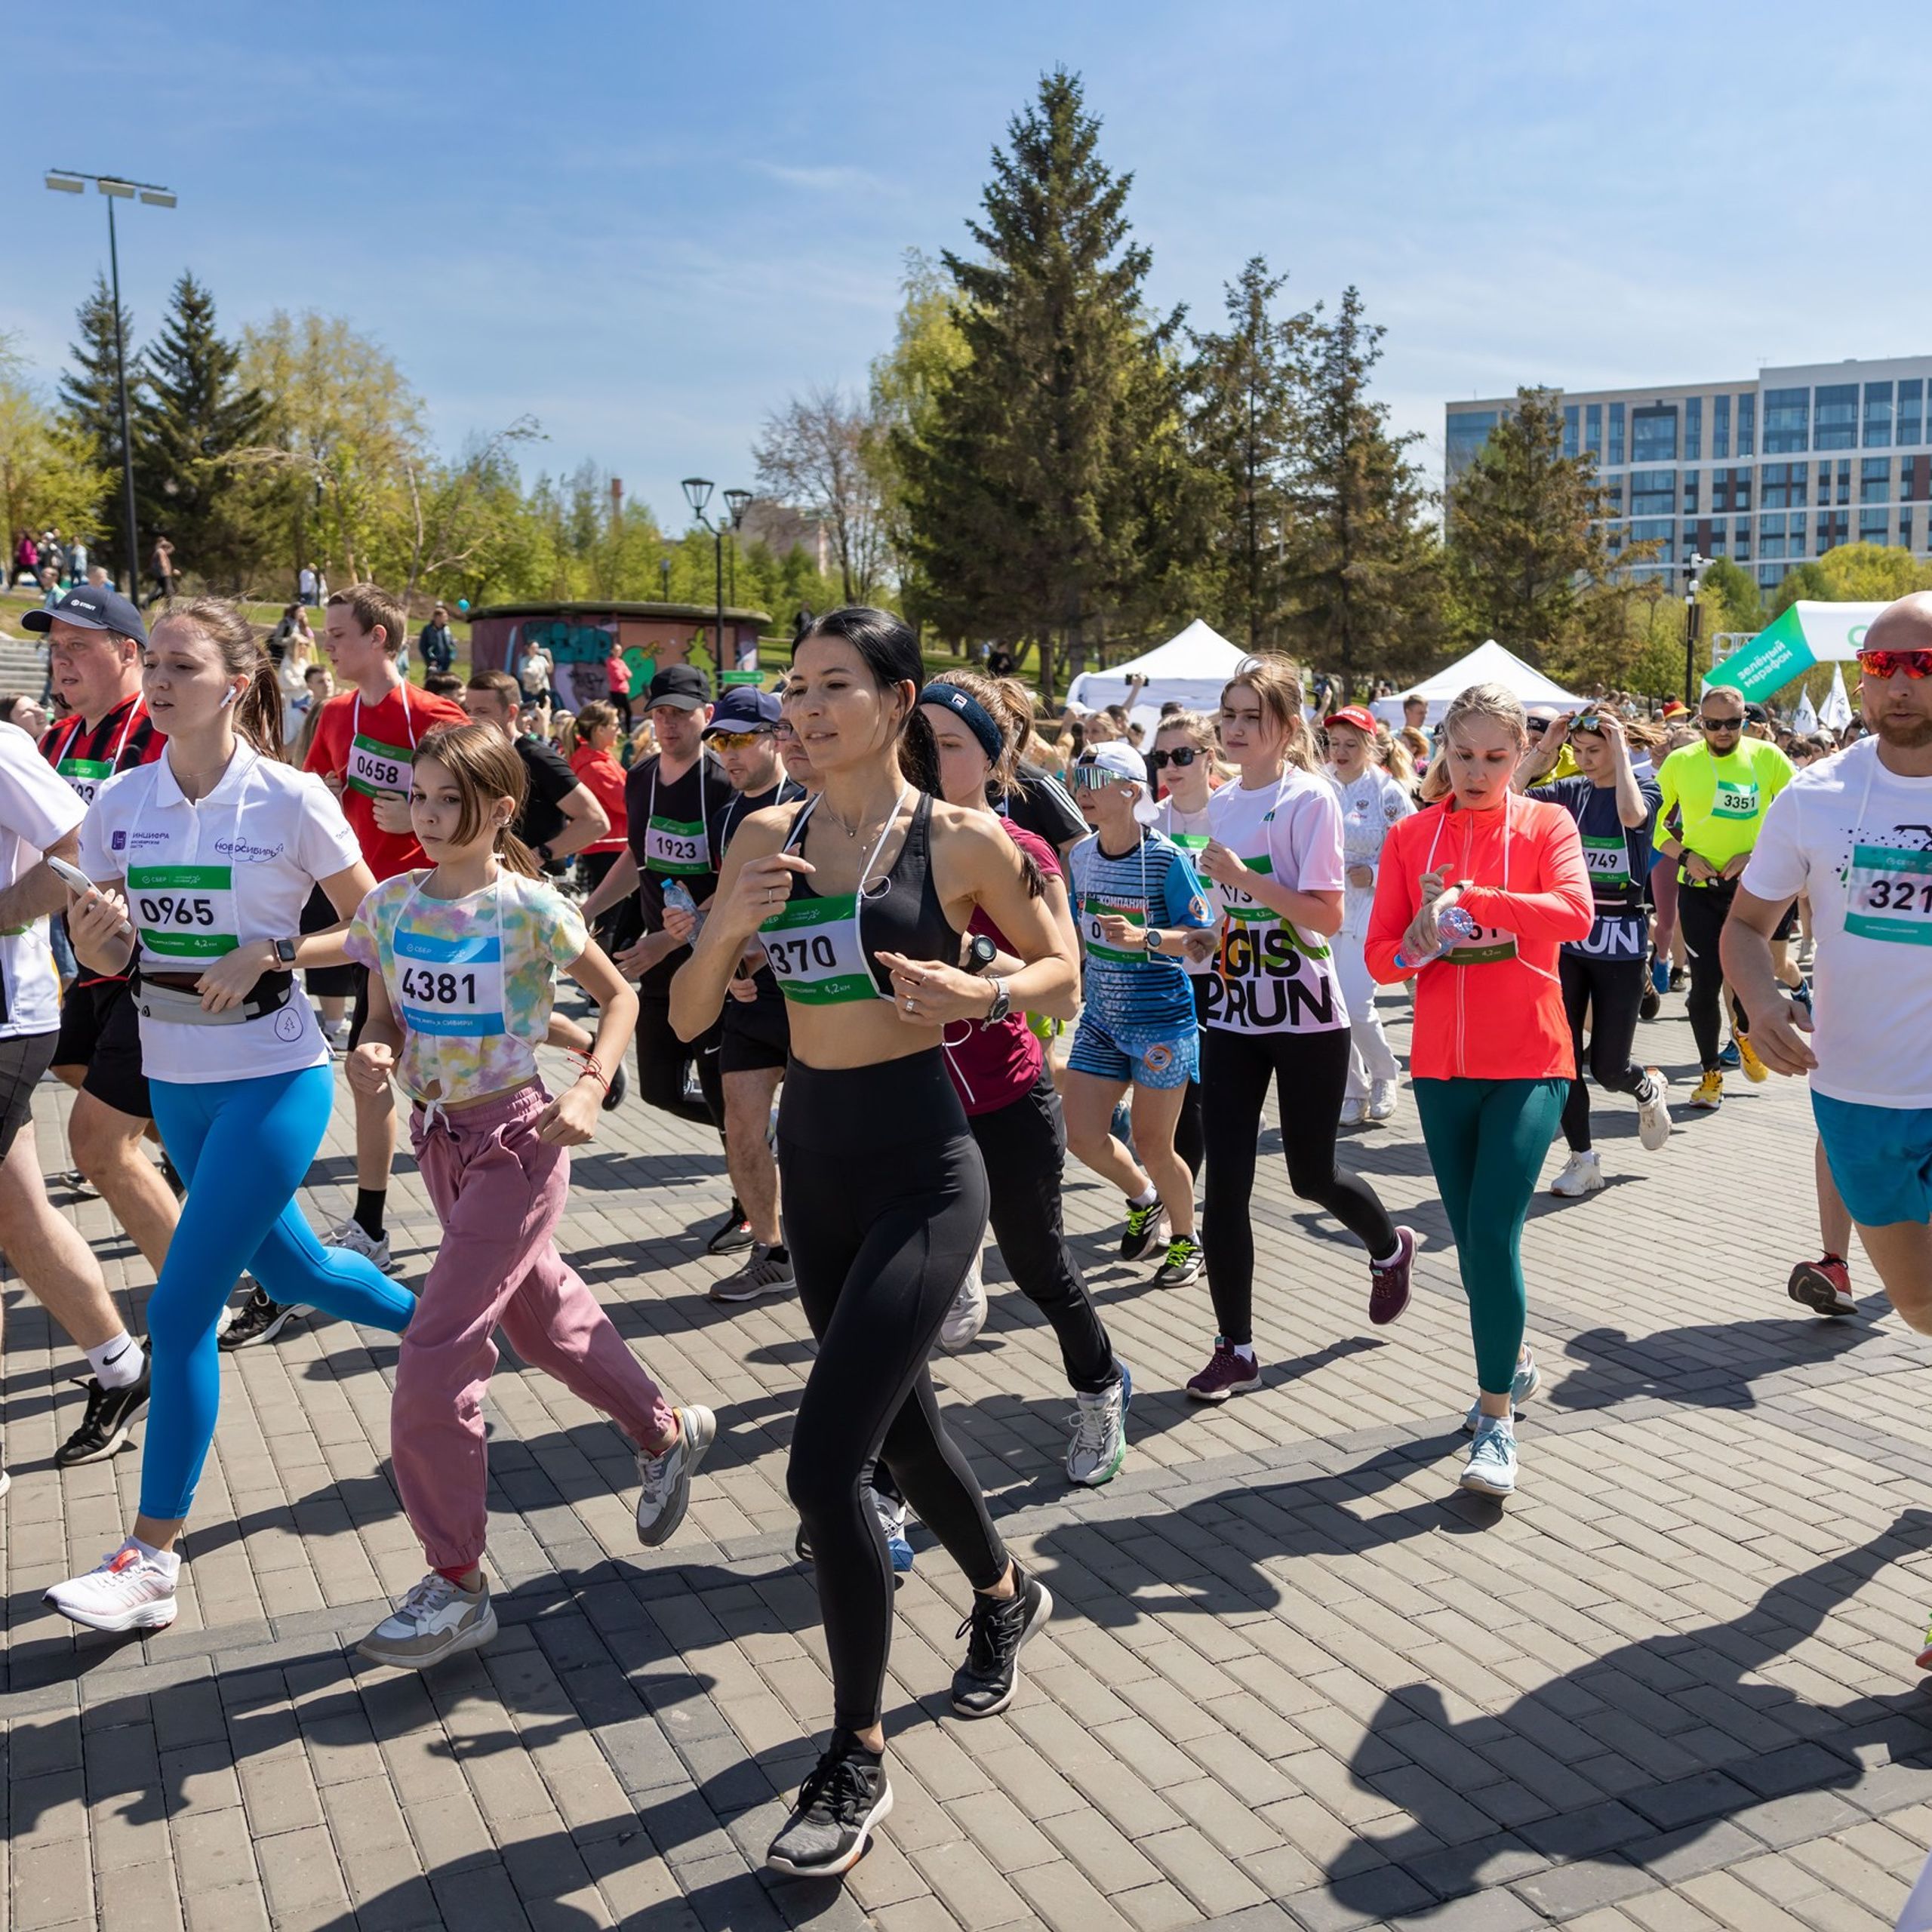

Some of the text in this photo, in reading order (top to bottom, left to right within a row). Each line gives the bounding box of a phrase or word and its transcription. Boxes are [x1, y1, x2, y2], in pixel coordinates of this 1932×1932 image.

[1737, 639, 1786, 680] зелёный
[1744, 649, 1793, 688] марафон
[358, 755, 398, 784] 0658
[1724, 794, 1755, 809] 3351
[657, 836, 696, 859] 1923
[1583, 851, 1617, 869] 749
[140, 897, 214, 926] 0965
[1563, 921, 1639, 955] UN
[761, 935, 837, 974] 370
[402, 968, 475, 1004] 4381
